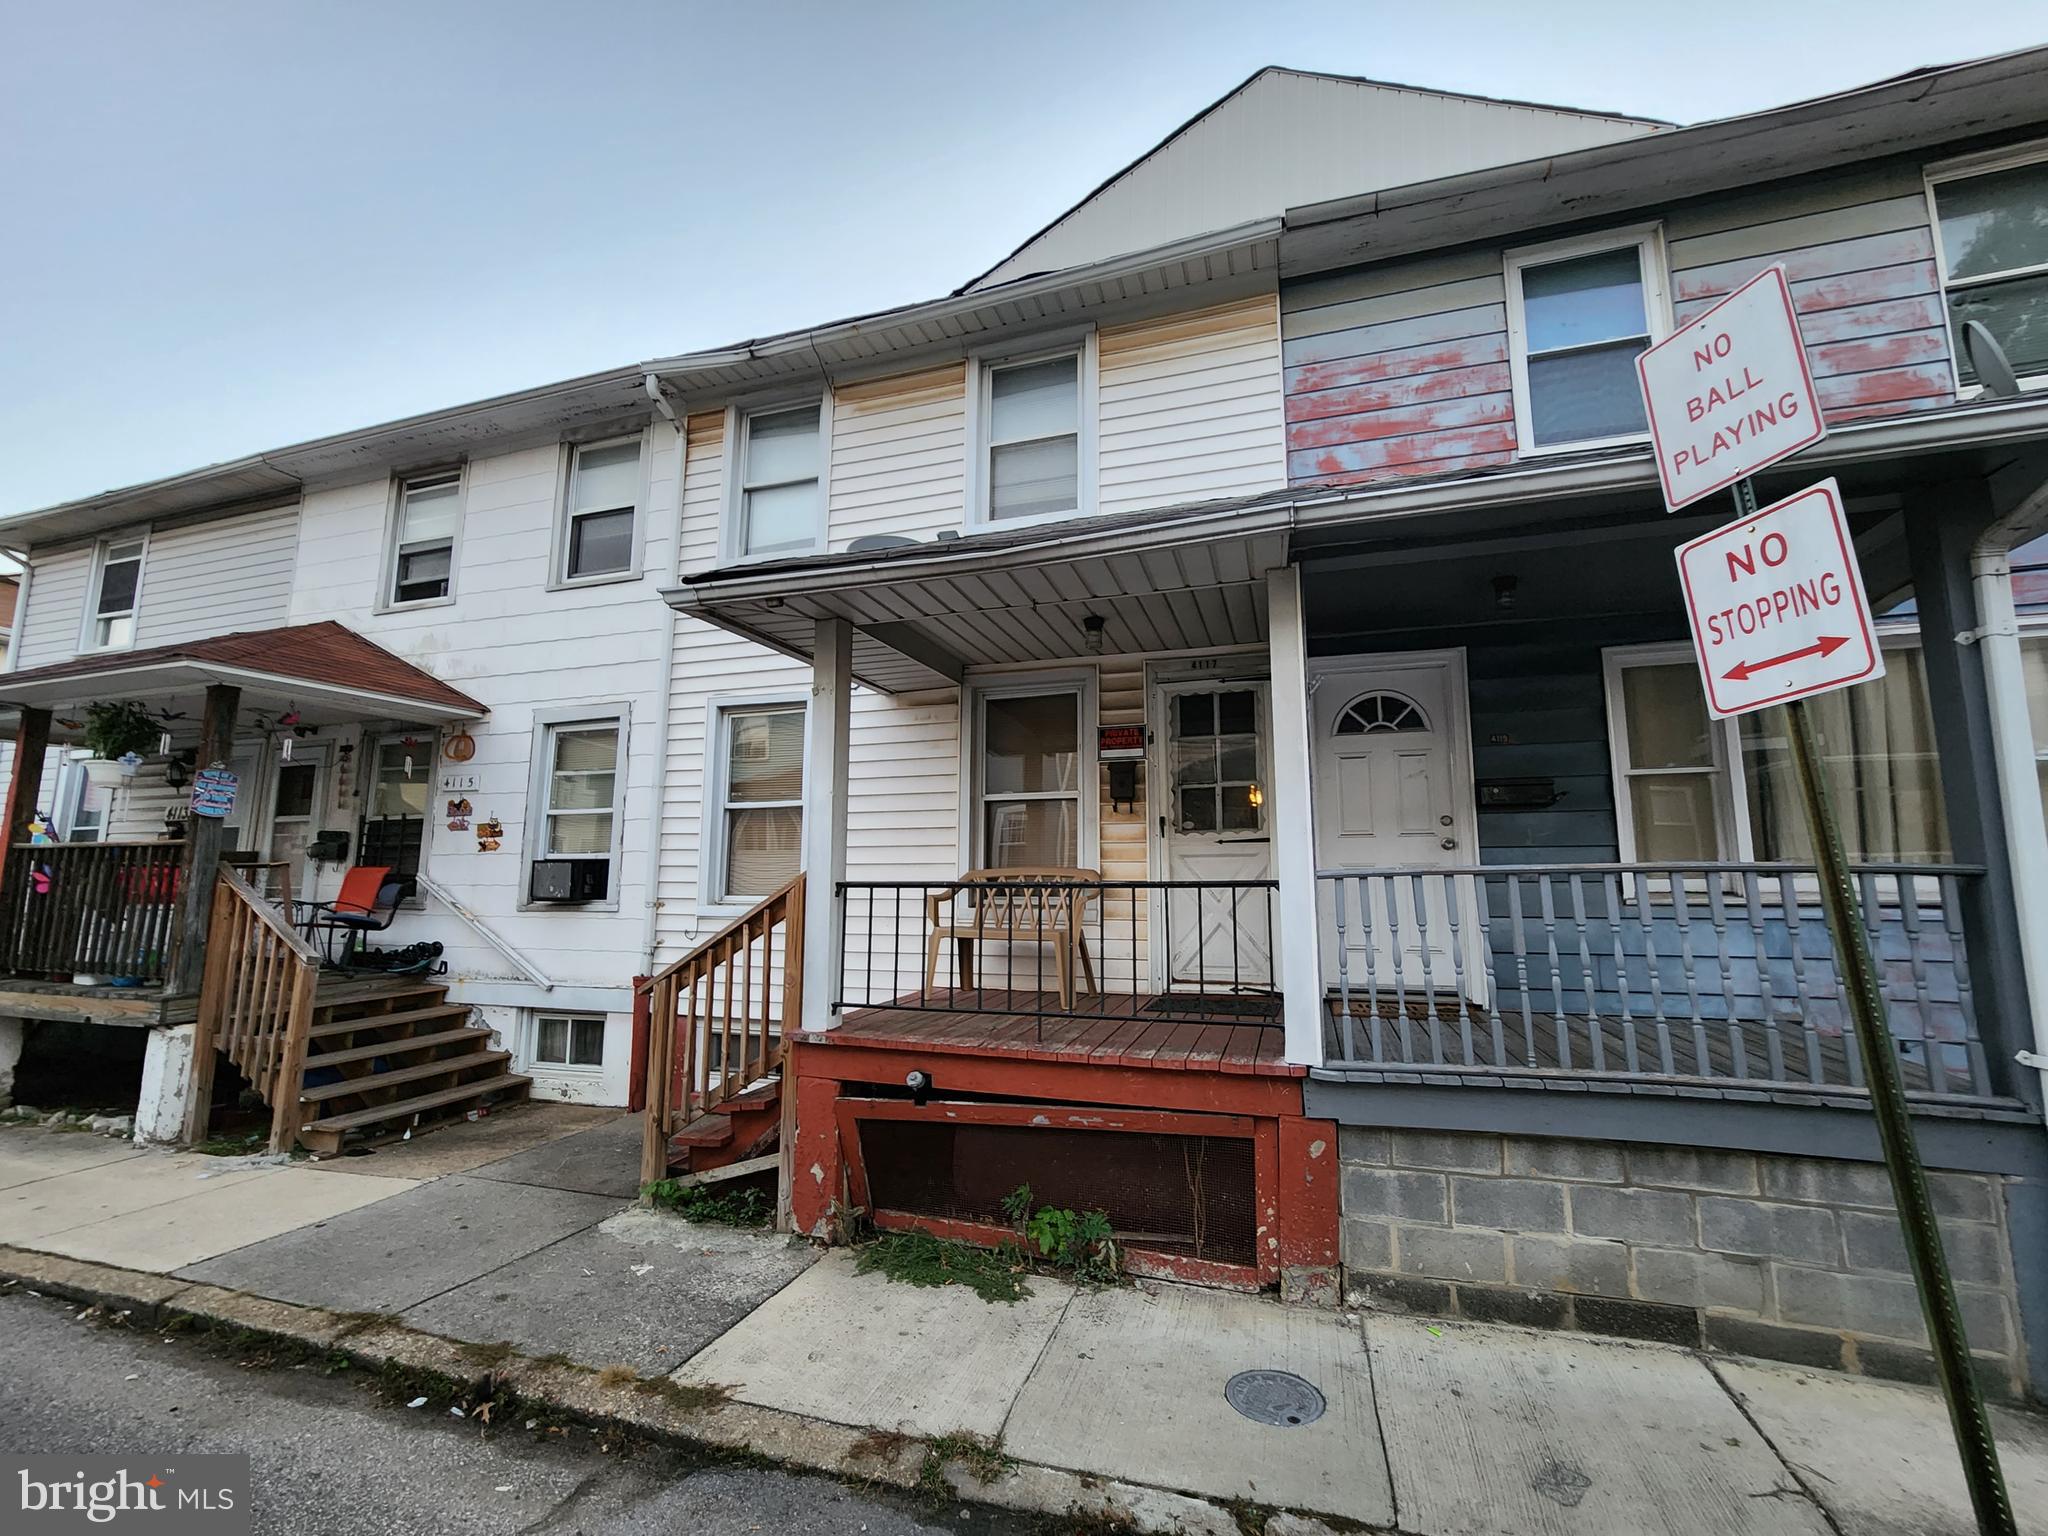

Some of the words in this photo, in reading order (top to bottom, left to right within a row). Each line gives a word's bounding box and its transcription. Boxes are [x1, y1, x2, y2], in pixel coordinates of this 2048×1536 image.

[1693, 332, 1732, 372] NO
[1687, 366, 1764, 423] BALL
[1672, 391, 1799, 476] PLAYING
[1725, 532, 1789, 583] NO
[1707, 572, 1842, 646] STOPPING
[1191, 659, 1217, 670] 4117
[1100, 736, 1143, 746] PROPERTY
[443, 776, 474, 788] 4115
